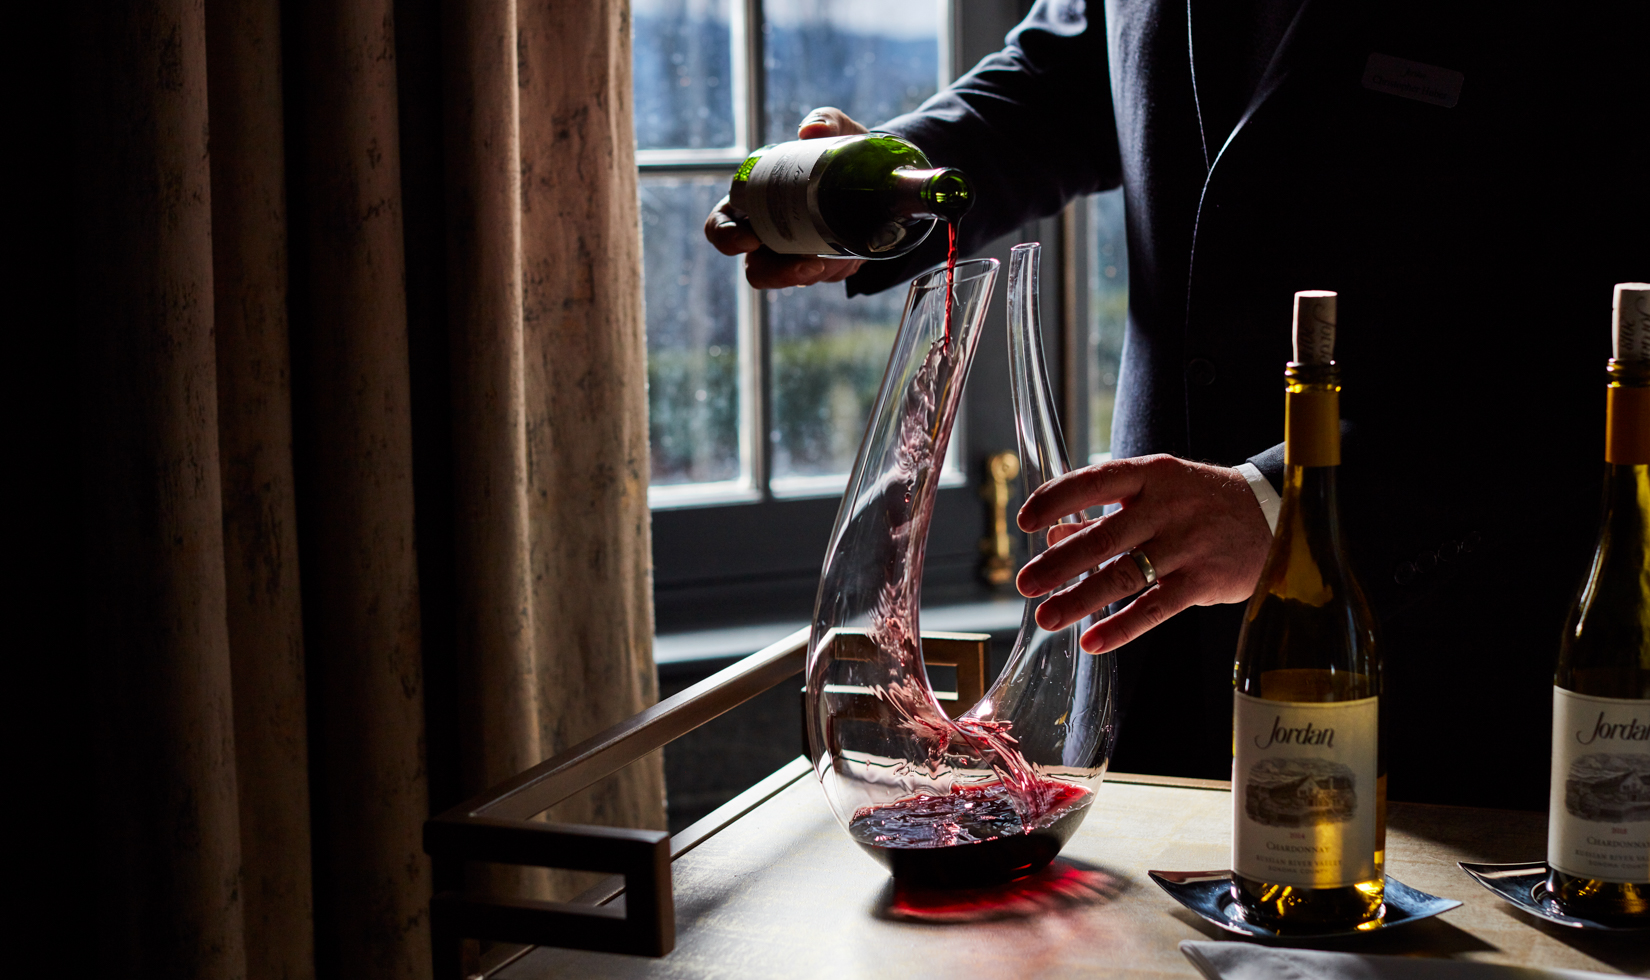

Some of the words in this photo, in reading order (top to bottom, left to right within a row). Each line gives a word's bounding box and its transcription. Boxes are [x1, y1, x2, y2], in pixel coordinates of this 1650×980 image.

[1312, 303, 1336, 363] Jorda
[1254, 715, 1335, 750] Jordan
[1266, 841, 1329, 853] CHARDONNAY
[1256, 854, 1286, 865] RUSSIAN
[1314, 859, 1342, 867] VALLEY
[1575, 849, 1607, 860] RUSSIAN
[1609, 854, 1634, 862] RIVER
[1268, 865, 1297, 873] SONOMA
[1588, 859, 1619, 868] SONOMA
